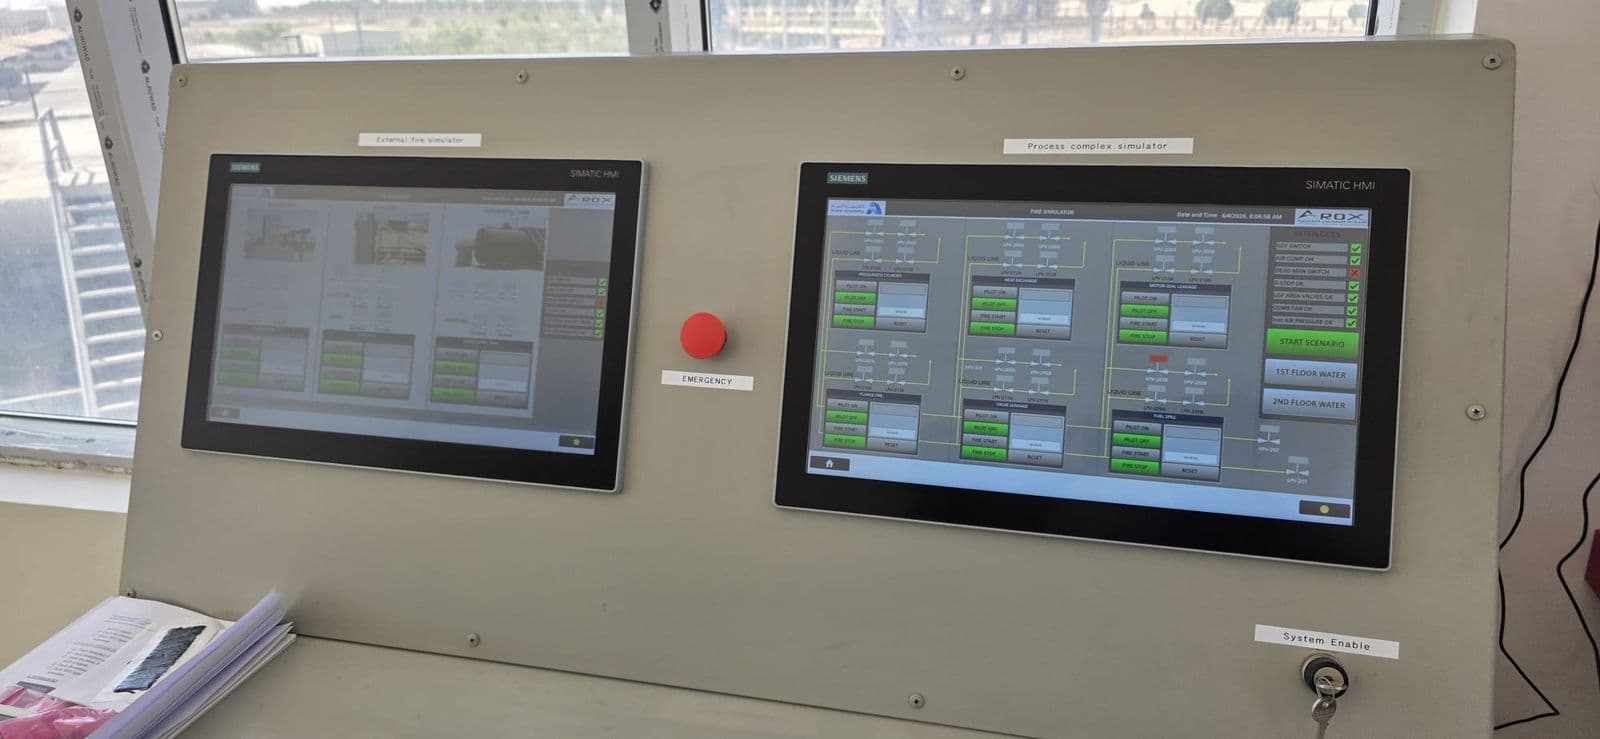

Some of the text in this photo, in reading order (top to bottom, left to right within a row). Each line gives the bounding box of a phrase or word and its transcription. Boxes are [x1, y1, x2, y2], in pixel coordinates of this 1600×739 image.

[570, 170, 619, 178] SIMATIC HMI
[828, 174, 867, 183] SIEMENS
[1306, 180, 1376, 190] SIMATIC HMI
[1280, 338, 1345, 348] START SCENARIO
[1290, 368, 1317, 377] FLOOR
[1318, 370, 1346, 379] WATER
[682, 376, 732, 385] EMERGENCY
[1290, 399, 1317, 407] FLOOR
[1318, 400, 1346, 409] WATER
[1283, 632, 1370, 650] System Enable
